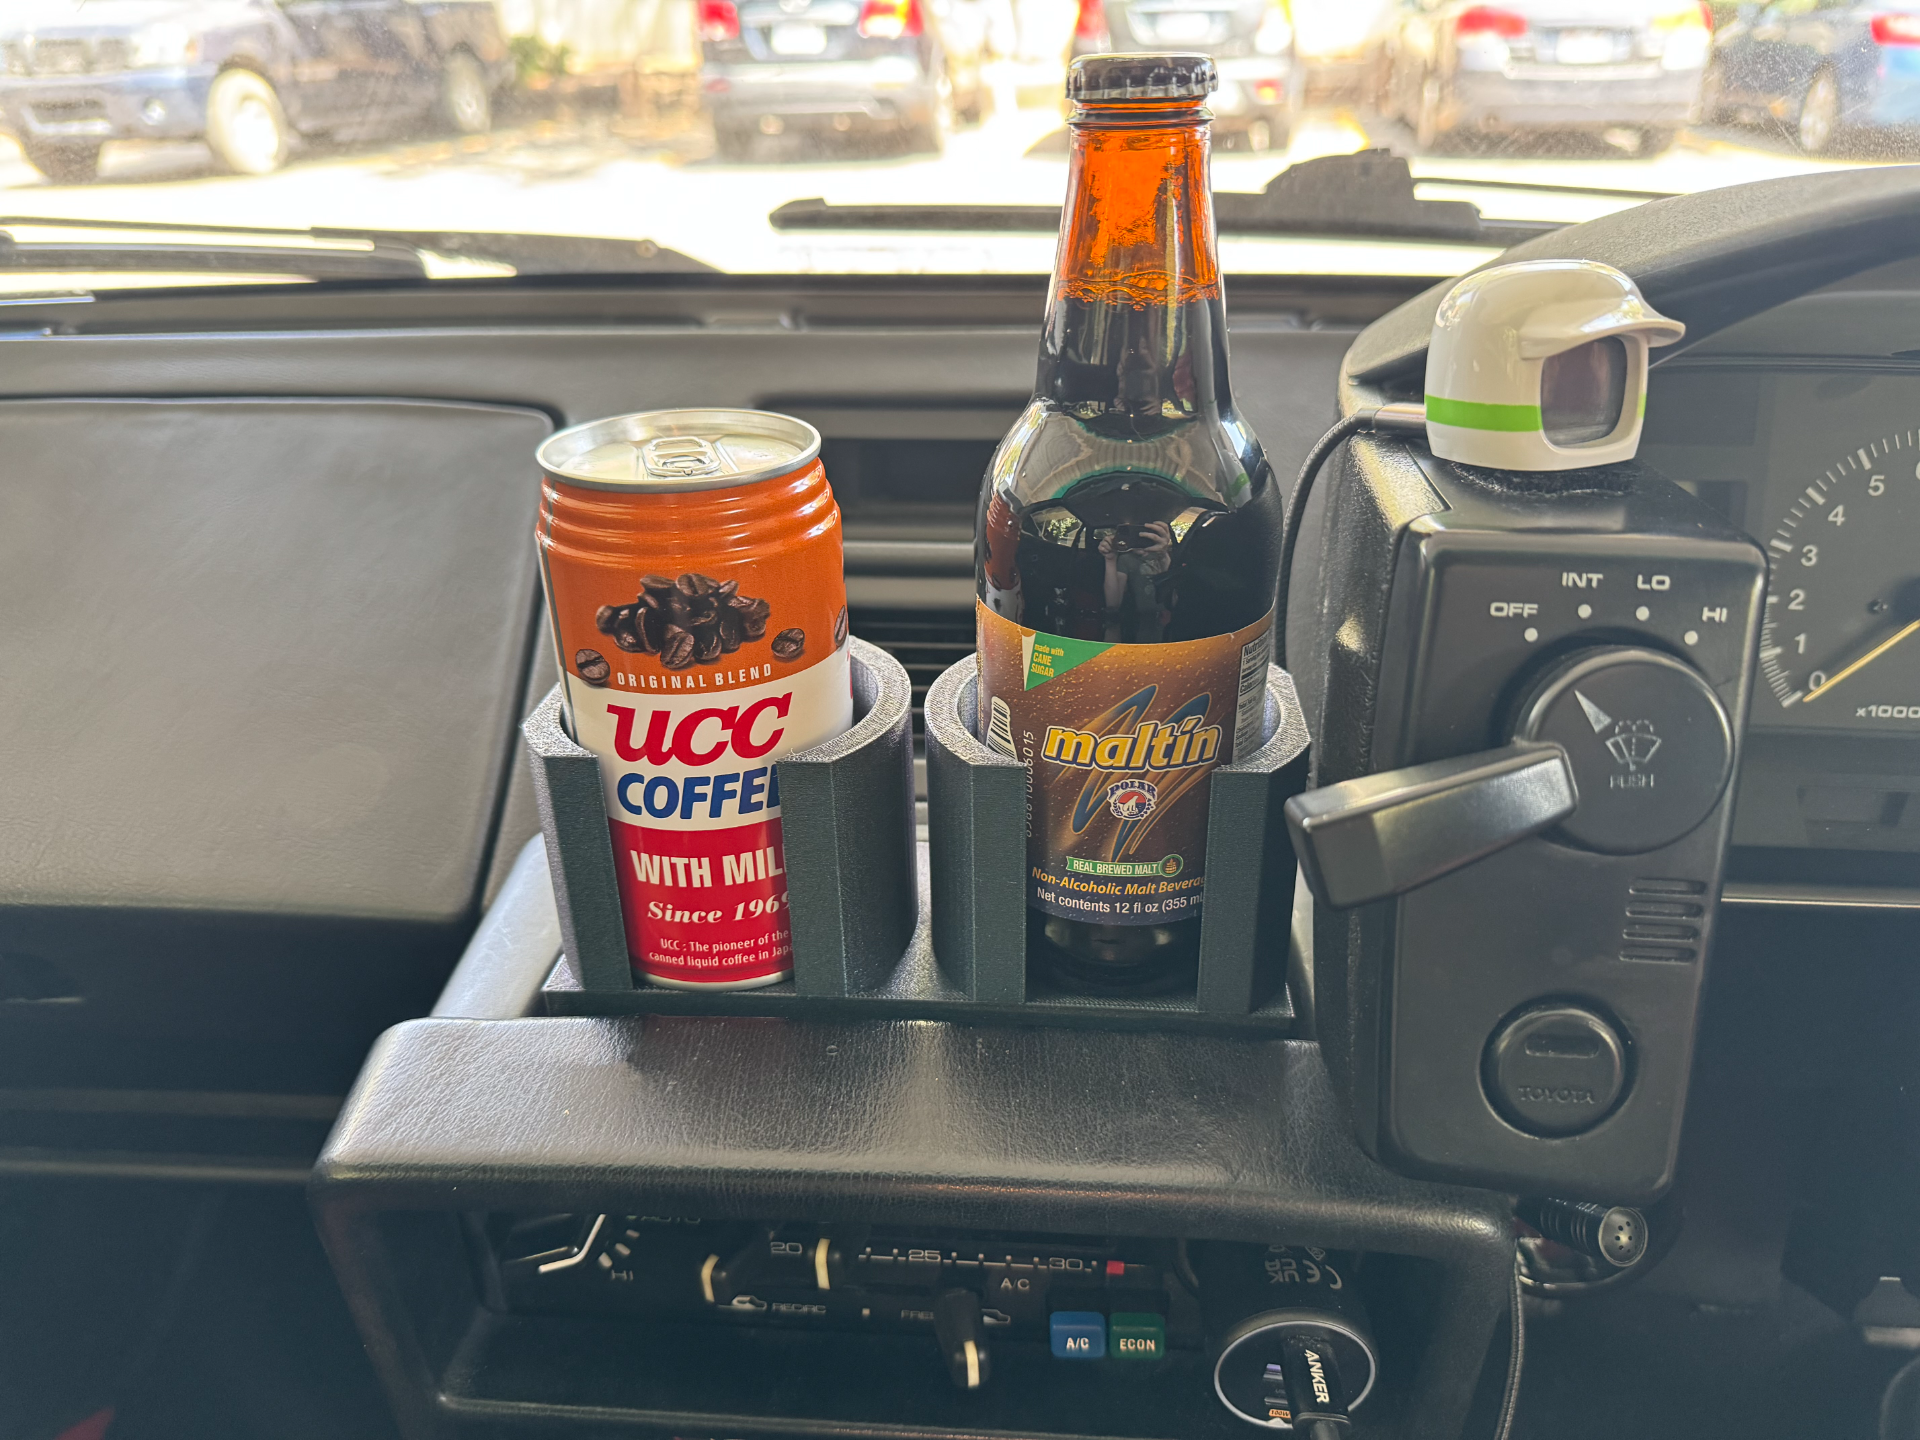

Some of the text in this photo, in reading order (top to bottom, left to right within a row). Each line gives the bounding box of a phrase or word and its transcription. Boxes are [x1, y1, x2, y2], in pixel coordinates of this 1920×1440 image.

[1868, 475, 1885, 496] 5
[1827, 504, 1845, 526] 4
[1801, 545, 1818, 567] 3
[1561, 572, 1603, 588] INT
[1637, 574, 1671, 590] LO
[1788, 589, 1806, 610] 2
[1489, 602, 1538, 618] OFF
[1702, 606, 1728, 623] HI
[1050, 647, 1064, 656] with
[1794, 633, 1807, 654] 1
[1033, 652, 1052, 666] CANE
[617, 663, 772, 689] ORIGINAL BLEND
[1031, 663, 1055, 678] SUGAR
[1808, 670, 1826, 691] 0
[1042, 716, 1221, 771] maltín
[1108, 780, 1157, 801] POLAR
[1609, 773, 1655, 789] PUSH
[630, 843, 787, 888] WITH MIL
[1073, 860, 1157, 875] REAL BREWED MALT
[1032, 867, 1206, 895] Non-Alcoholic Malt Beverag
[1037, 887, 1056, 903] Net
[1058, 896, 1110, 912] contents
[1114, 902, 1130, 913] 12
[1133, 901, 1141, 913] fl
[1145, 903, 1159, 912] oz
[1162, 896, 1187, 913] (355
[647, 901, 722, 923] Since
[660, 938, 680, 950] UCC
[690, 941, 709, 952] The
[712, 939, 755, 954] pioneer
[758, 933, 770, 945] of
[772, 930, 789, 941] the
[649, 943, 793, 968] canned liquid coffee in Japa
[1517, 1085, 1595, 1104] TOYOTA
[770, 1242, 802, 1255] 20
[908, 1249, 941, 1262] 25
[1049, 1257, 1083, 1270] 30
[1000, 1278, 1030, 1290] A/C
[1066, 1337, 1089, 1350] A/C
[1119, 1338, 1155, 1351] ECON
[1304, 1349, 1330, 1404] ANKER
